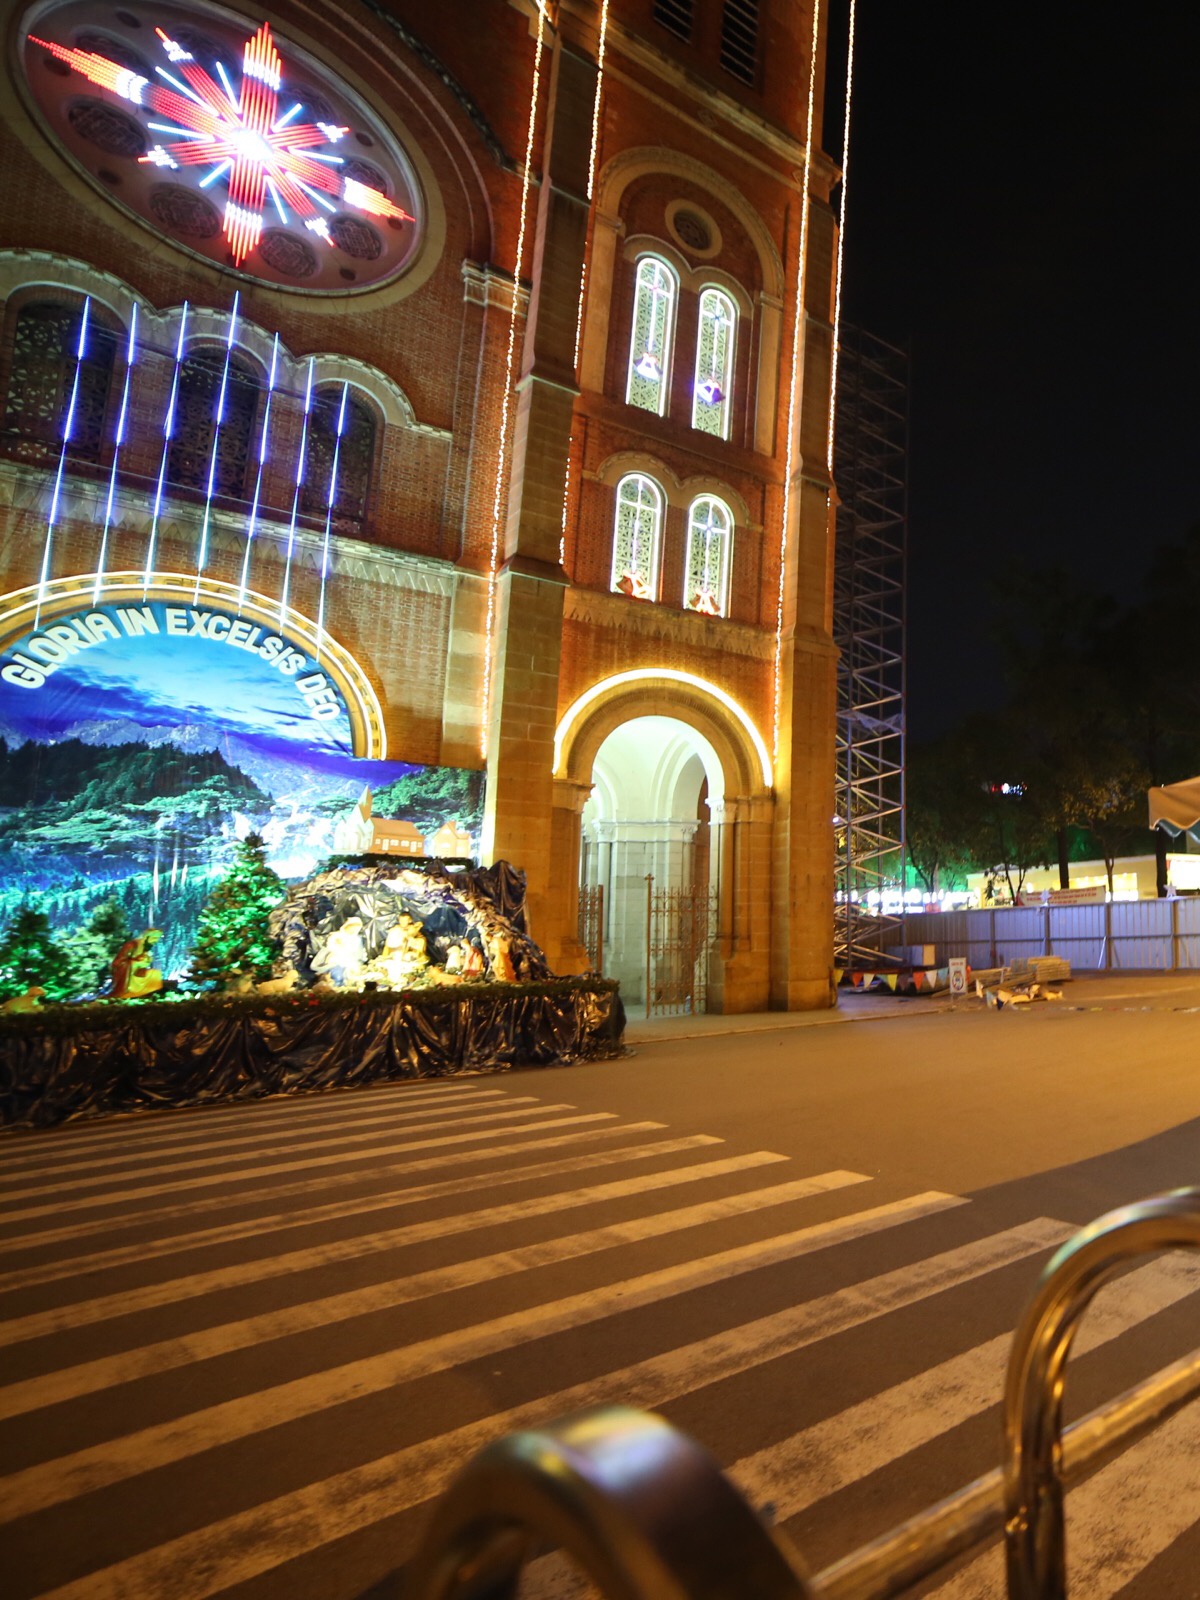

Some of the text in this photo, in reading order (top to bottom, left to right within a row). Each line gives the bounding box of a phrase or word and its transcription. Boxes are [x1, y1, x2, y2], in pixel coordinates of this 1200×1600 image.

[1, 606, 341, 721] GLORIA IN EXCELSIS DEO
